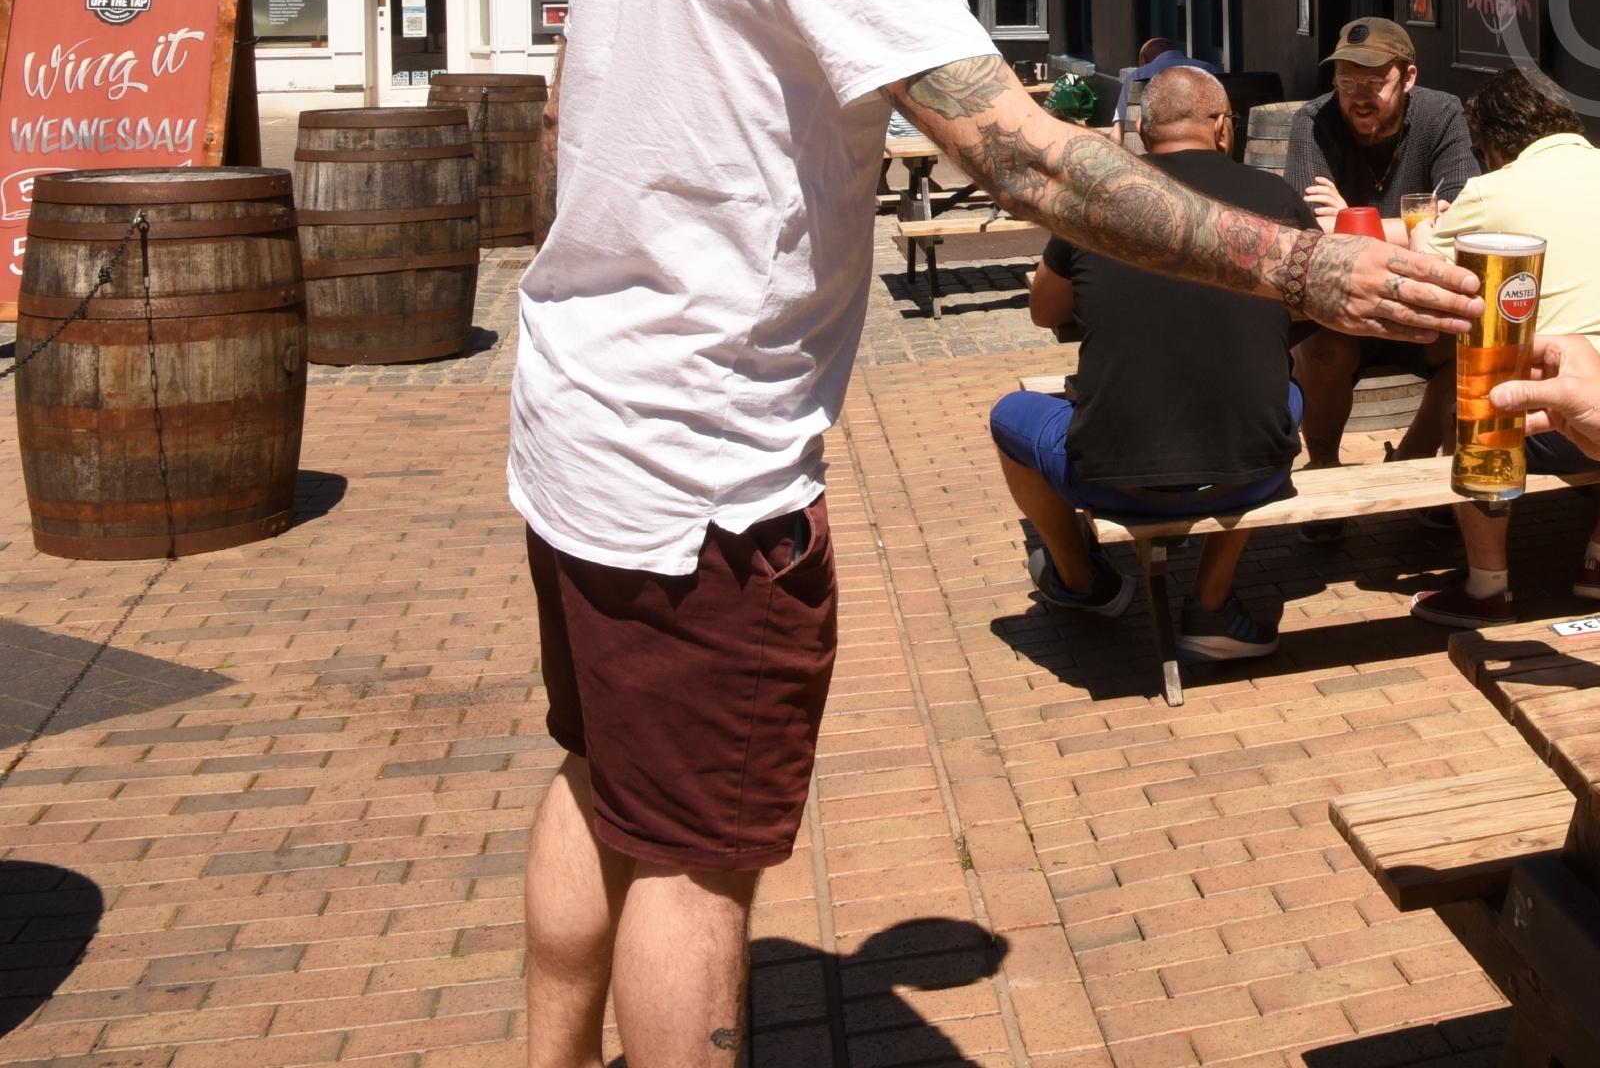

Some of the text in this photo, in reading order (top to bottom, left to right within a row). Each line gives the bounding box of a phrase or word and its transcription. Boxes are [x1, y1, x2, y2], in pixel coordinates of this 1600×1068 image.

[24, 27, 206, 100] Wing it
[11, 115, 198, 154] WEDNESDAY
